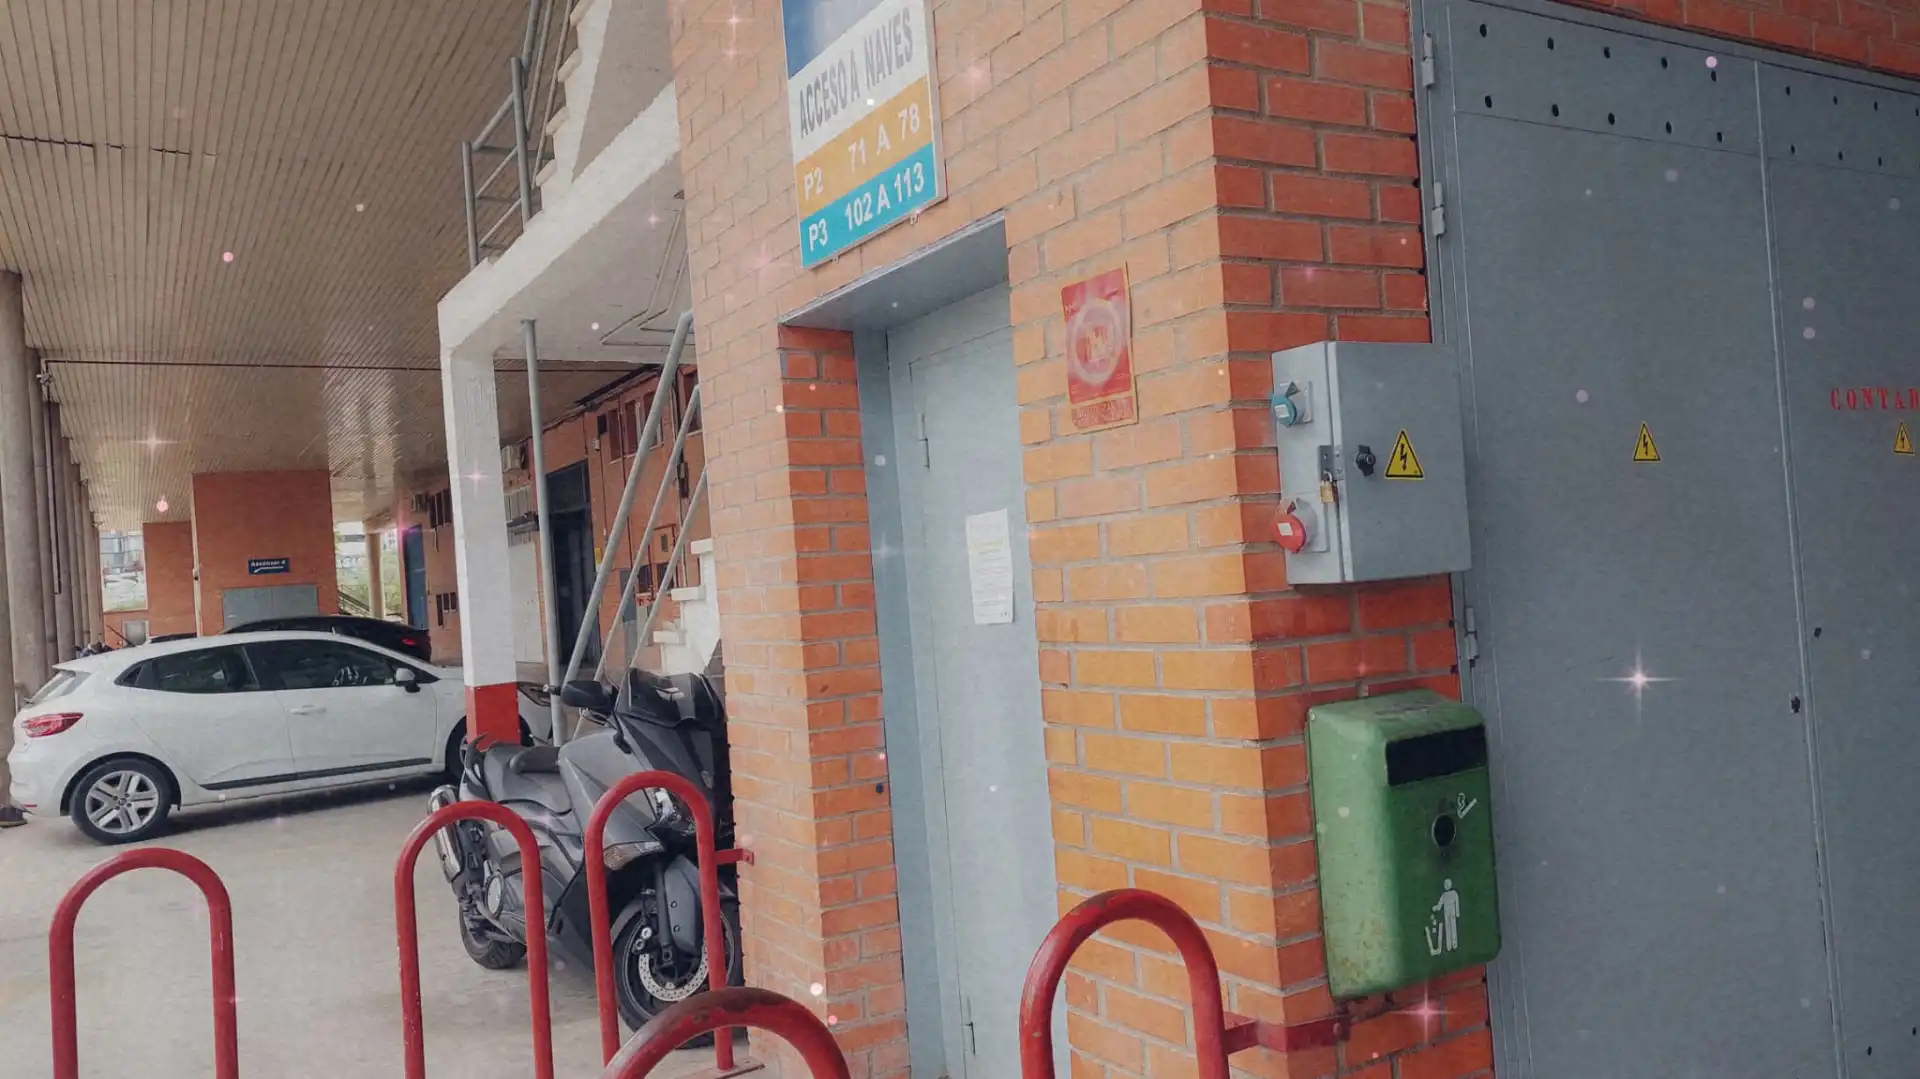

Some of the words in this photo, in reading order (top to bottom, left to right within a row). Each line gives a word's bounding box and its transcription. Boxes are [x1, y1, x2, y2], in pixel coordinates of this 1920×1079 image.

[800, 58, 849, 139] ACCESO
[850, 51, 861, 103] A
[864, 6, 914, 91] NAVES
[804, 167, 824, 201] P2
[848, 137, 867, 173] 71
[876, 124, 891, 156] A
[898, 103, 920, 140] 78
[808, 218, 828, 251] P3
[845, 192, 873, 231] 102
[877, 184, 891, 215] A
[894, 162, 925, 202] 113
